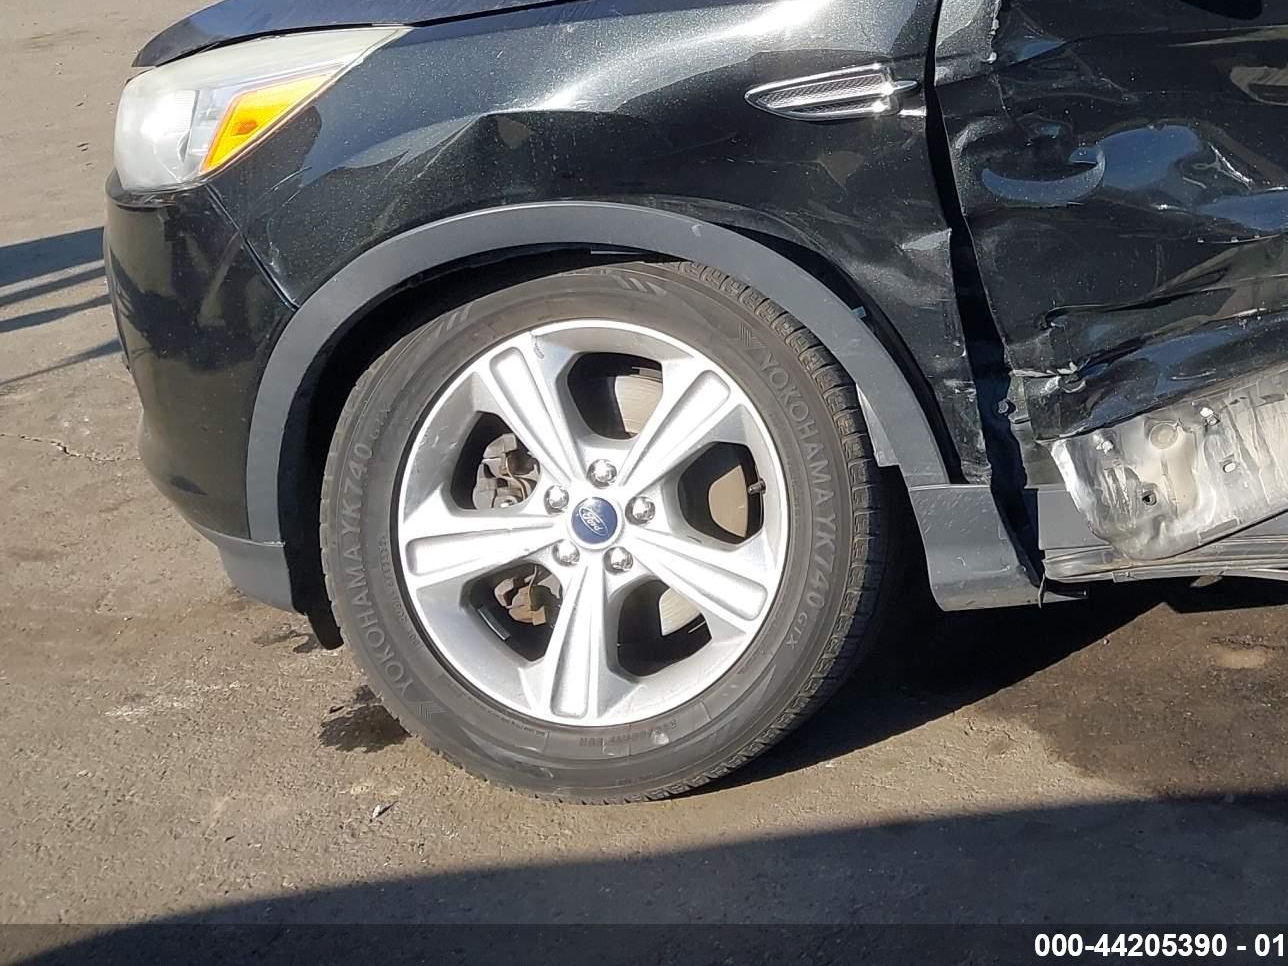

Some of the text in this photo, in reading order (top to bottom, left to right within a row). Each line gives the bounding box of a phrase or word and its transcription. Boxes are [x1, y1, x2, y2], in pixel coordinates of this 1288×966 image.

[342, 442, 374, 536] YK740
[759, 352, 841, 652] YOKOHAMA YK740 GTX
[342, 548, 416, 701] YOKOHAMA
